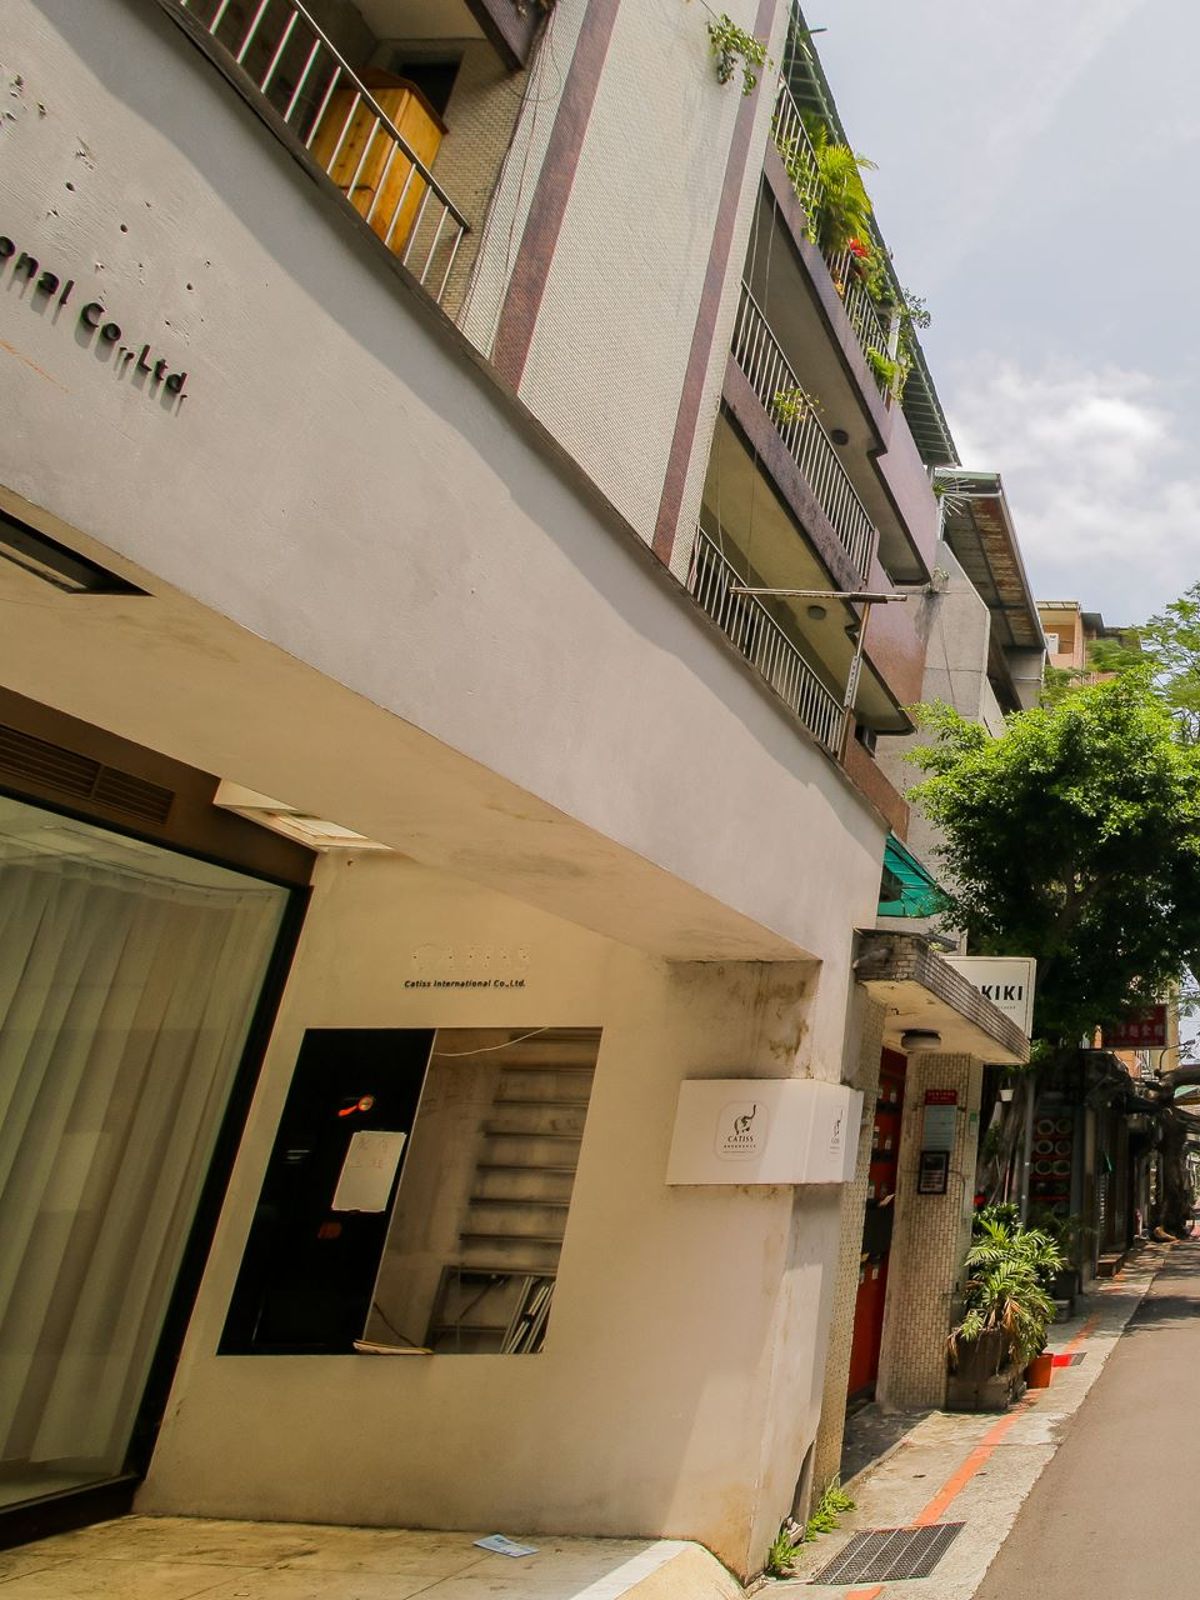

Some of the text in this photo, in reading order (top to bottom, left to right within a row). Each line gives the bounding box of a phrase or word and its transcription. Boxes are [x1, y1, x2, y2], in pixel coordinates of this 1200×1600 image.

[404, 980, 430, 988] Catiss
[433, 979, 491, 988] International
[972, 985, 1023, 1001] KIKI
[727, 1135, 754, 1143] CATISS
